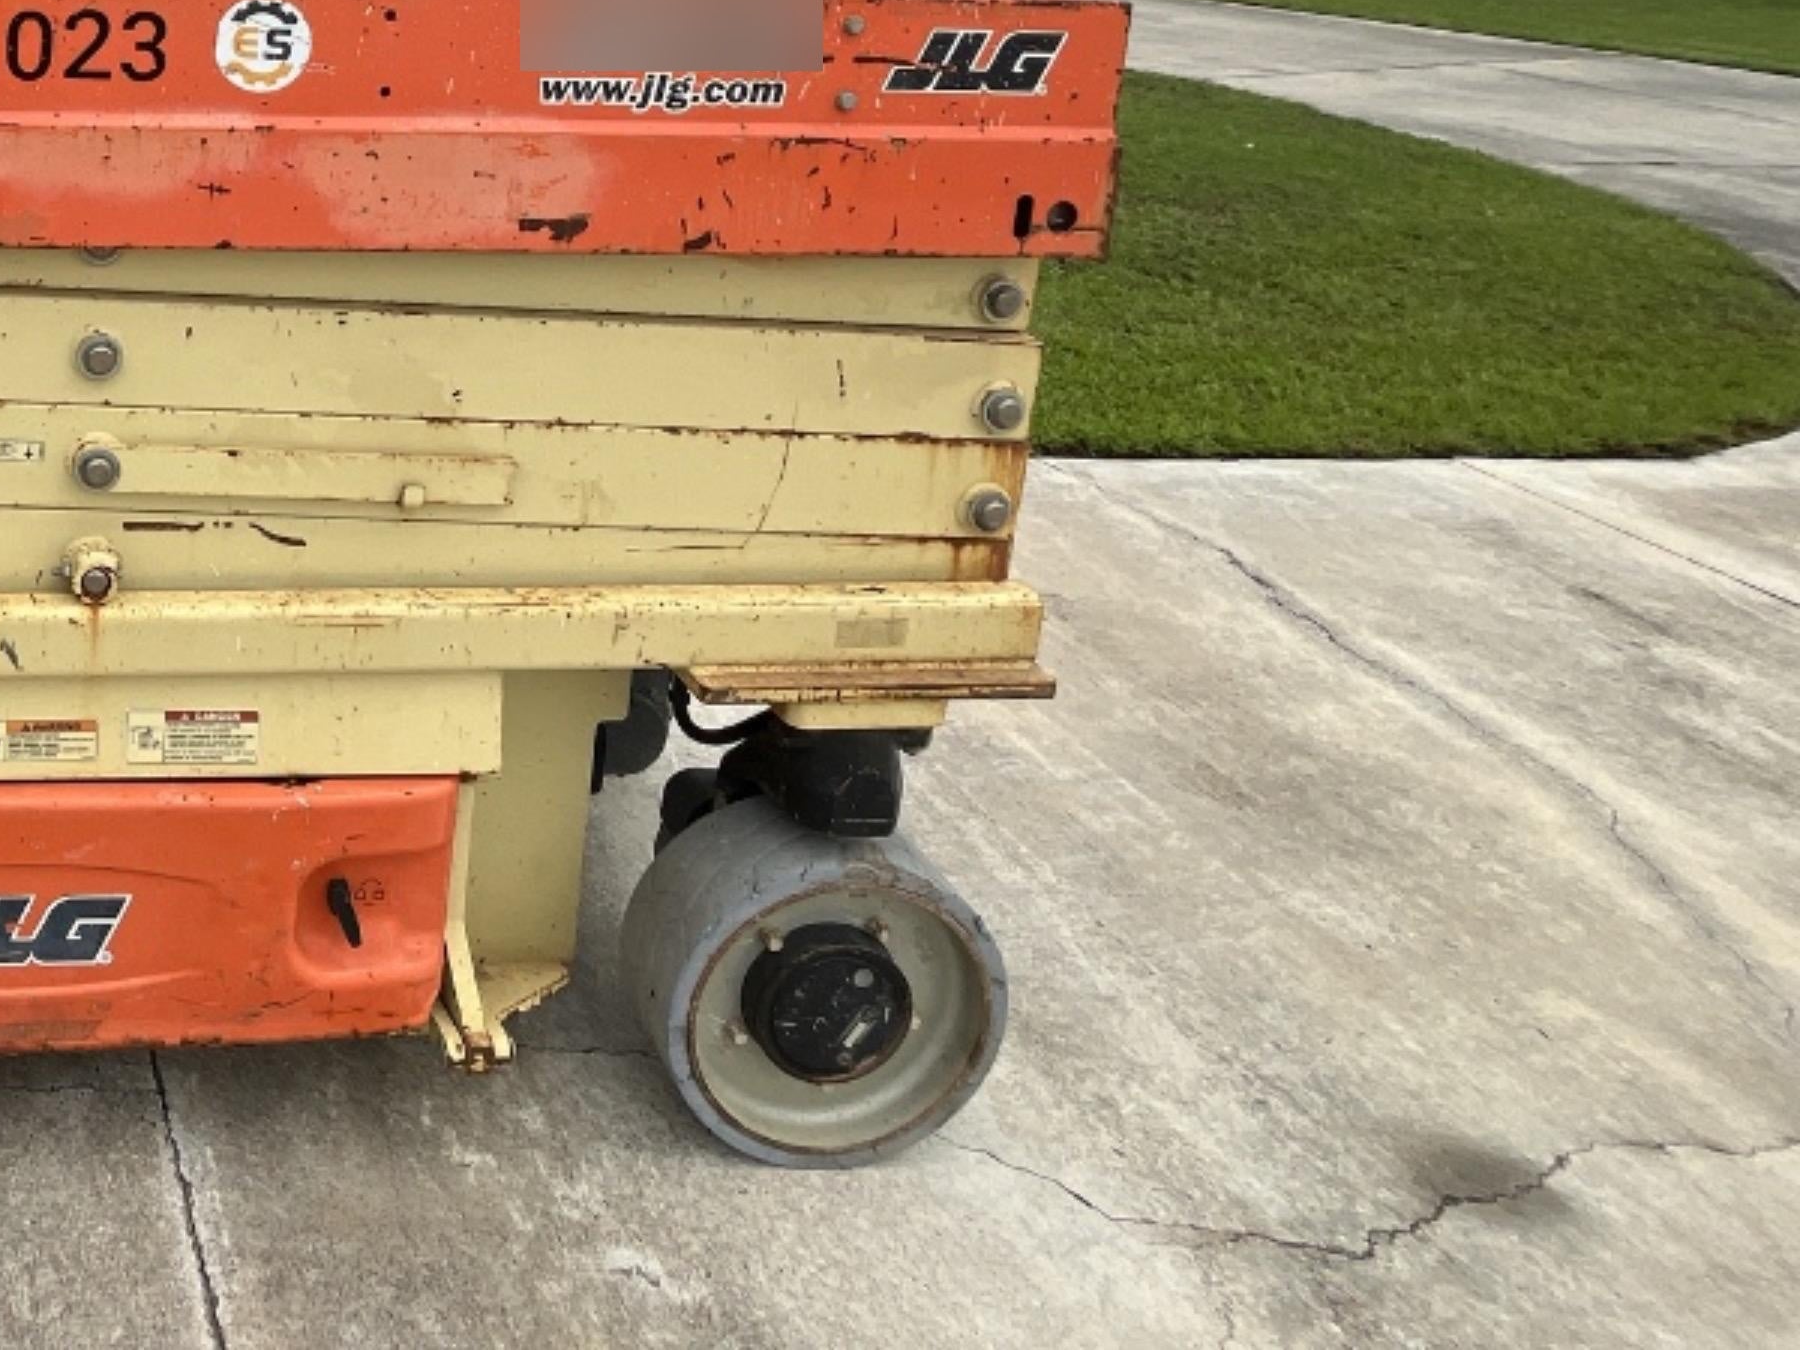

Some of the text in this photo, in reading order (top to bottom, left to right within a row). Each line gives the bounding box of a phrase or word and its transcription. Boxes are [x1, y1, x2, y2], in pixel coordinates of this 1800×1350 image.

[232, 26, 294, 61] ES
[882, 27, 1069, 96] JLG
[540, 72, 787, 114] www.jlg.com
